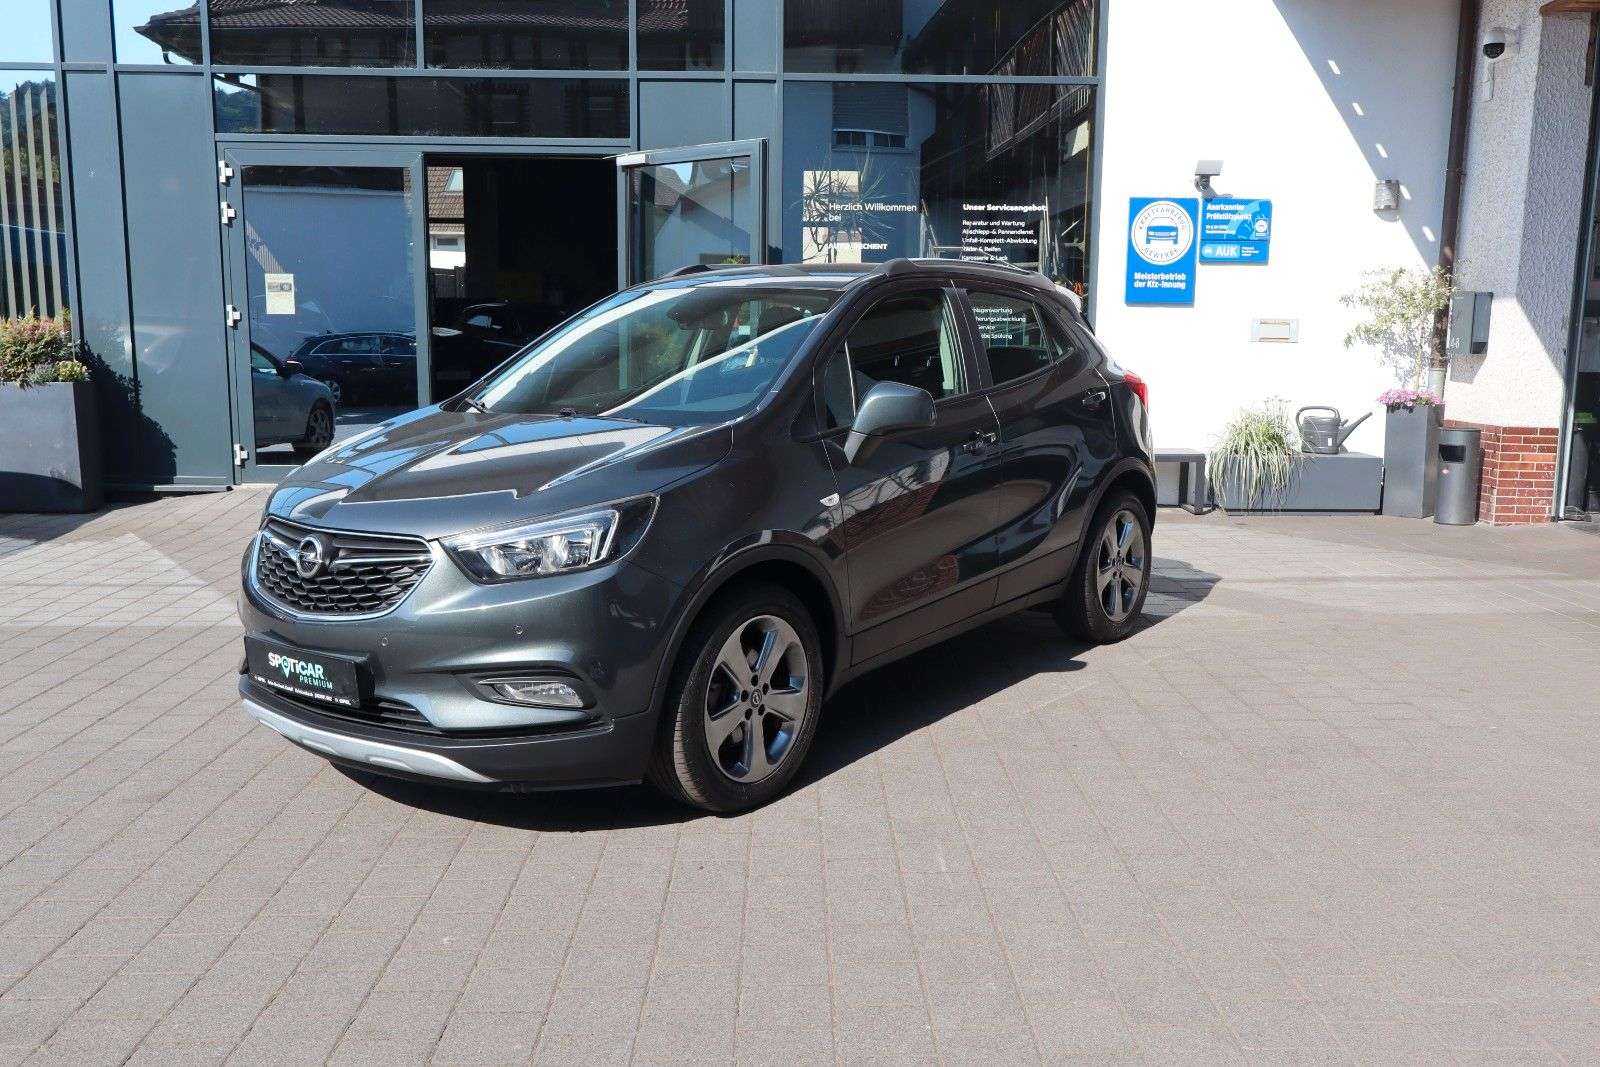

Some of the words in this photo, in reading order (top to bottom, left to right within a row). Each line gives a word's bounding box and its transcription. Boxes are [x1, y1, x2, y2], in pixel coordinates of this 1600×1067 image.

[829, 203, 863, 211] Herzlich
[864, 203, 917, 212] Willkommen
[828, 214, 842, 222] bei
[1216, 246, 1238, 257] AUK
[1134, 272, 1186, 280] Meisterbetrieb
[1147, 281, 1186, 289] Kfz-Innung
[300, 675, 333, 689] PREMIUM
